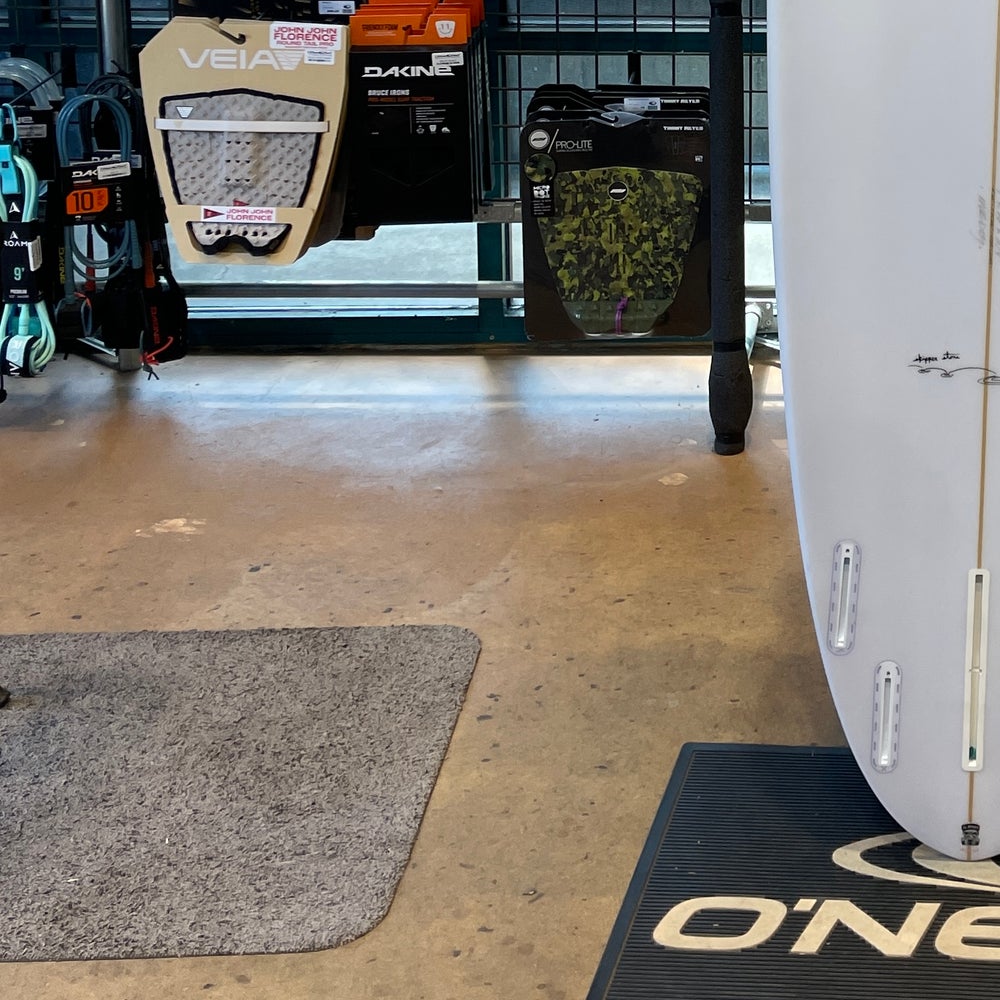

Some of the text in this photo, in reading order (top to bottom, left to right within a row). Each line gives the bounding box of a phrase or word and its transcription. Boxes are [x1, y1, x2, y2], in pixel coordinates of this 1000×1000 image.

[274, 26, 337, 35] JOHN JOHN
[273, 33, 337, 42] FLORENCE
[178, 48, 281, 71] VEIA
[361, 65, 455, 78] DAKINE
[555, 139, 593, 149] PRO-LITE
[72, 191, 94, 212] 10
